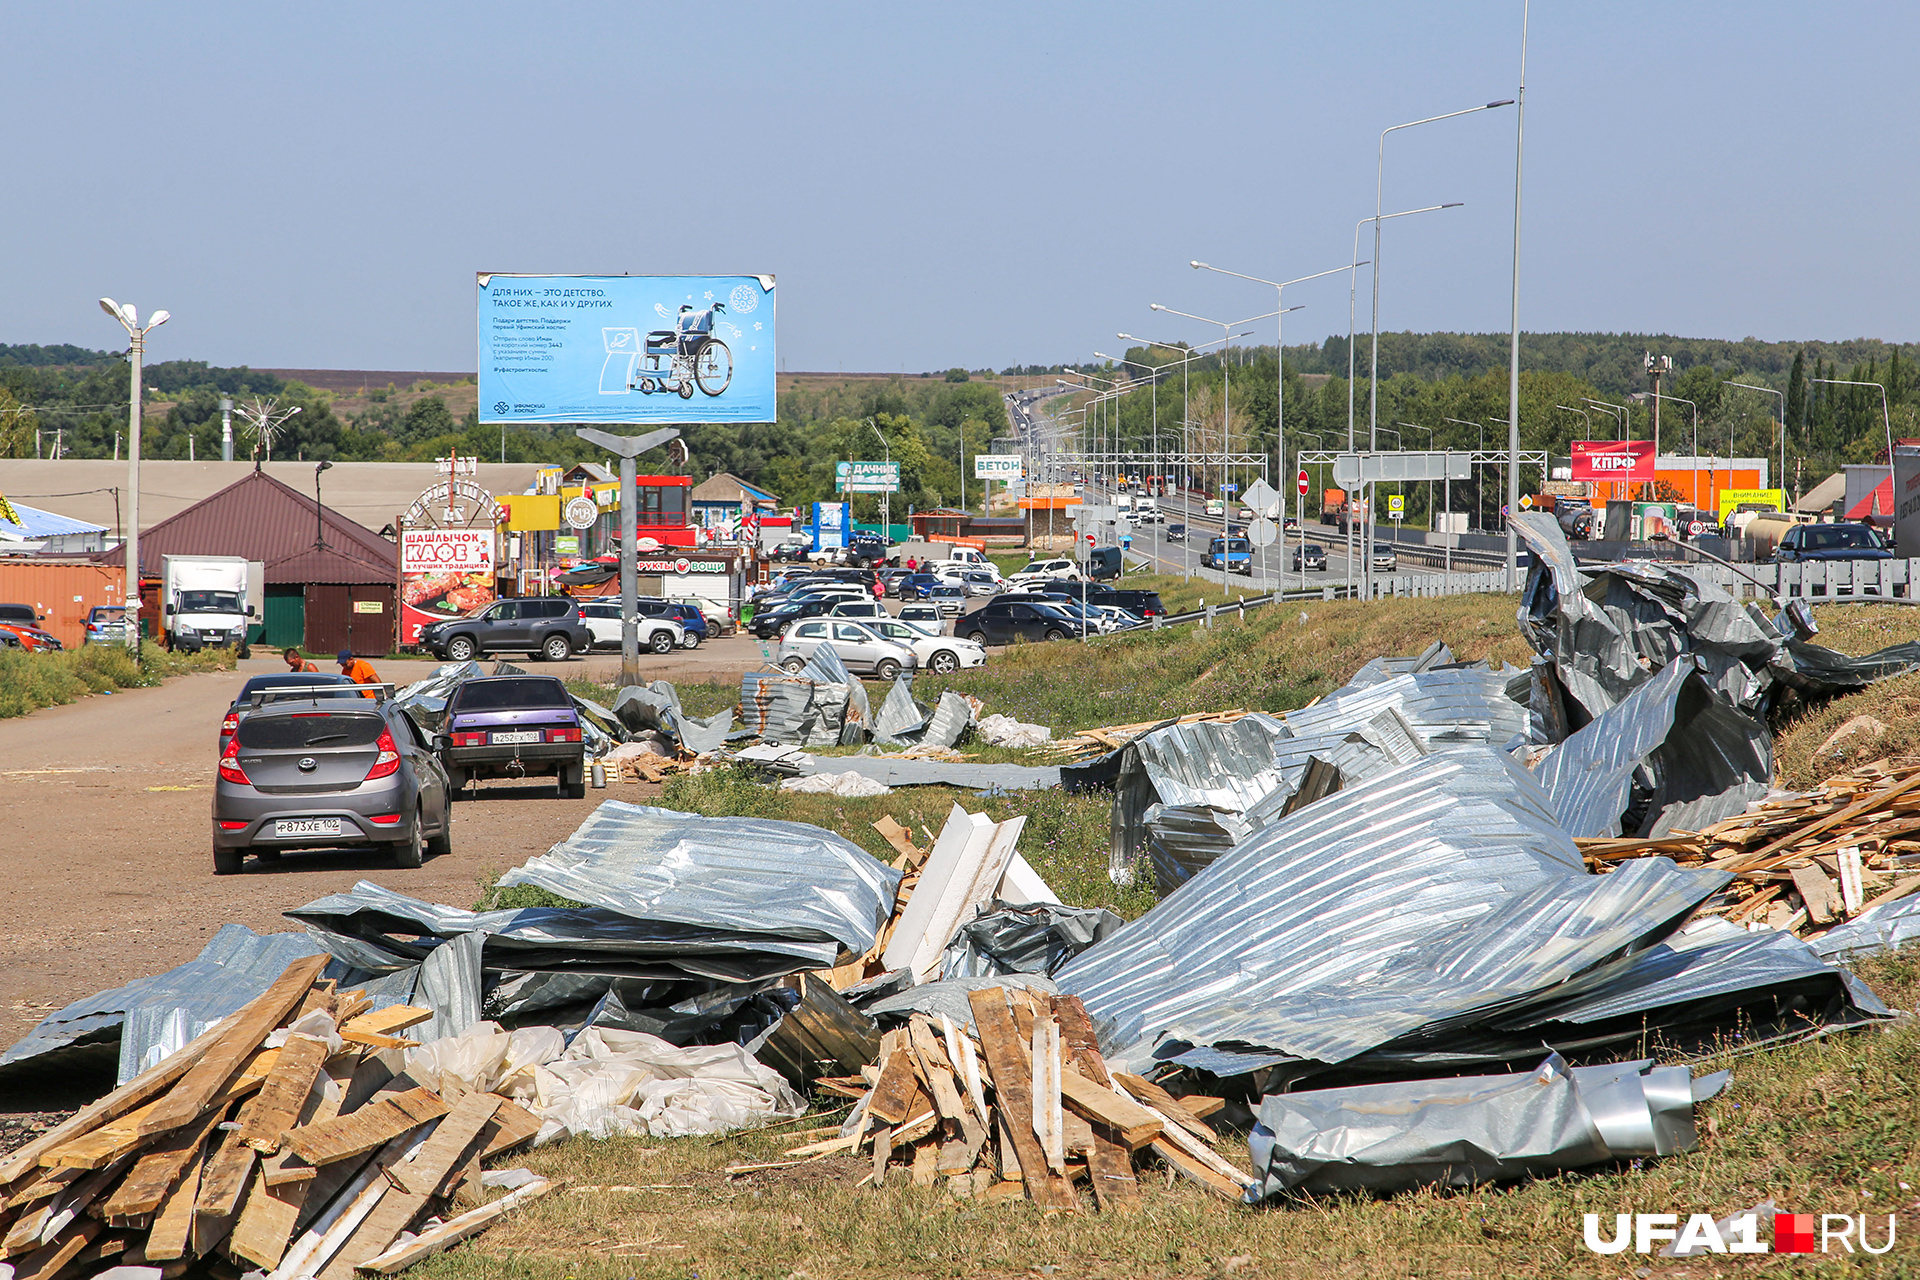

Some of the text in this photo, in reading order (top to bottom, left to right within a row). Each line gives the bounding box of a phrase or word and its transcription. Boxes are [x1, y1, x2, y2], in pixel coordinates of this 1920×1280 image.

[492, 288, 512, 297] ДЛЯ
[514, 288, 533, 296] НИХ
[544, 288, 562, 296] ЭТО
[563, 288, 606, 297] ДЕТСТВО.
[492, 300, 522, 308] ТАКОЕ
[524, 300, 540, 308] ЖЕ,
[540, 300, 559, 308] КАК
[577, 300, 612, 308] ДРУГИХ
[977, 461, 1020, 470] БЕТОН
[1591, 456, 1636, 469] КПРФ
[854, 464, 898, 474] ДАЧНИК
[405, 534, 479, 542] ШАШЛЫЧОК
[406, 543, 468, 562] КАФЕ
[636, 560, 674, 571] РУКТЫ
[280, 820, 338, 832] Р873ХЕ 102
